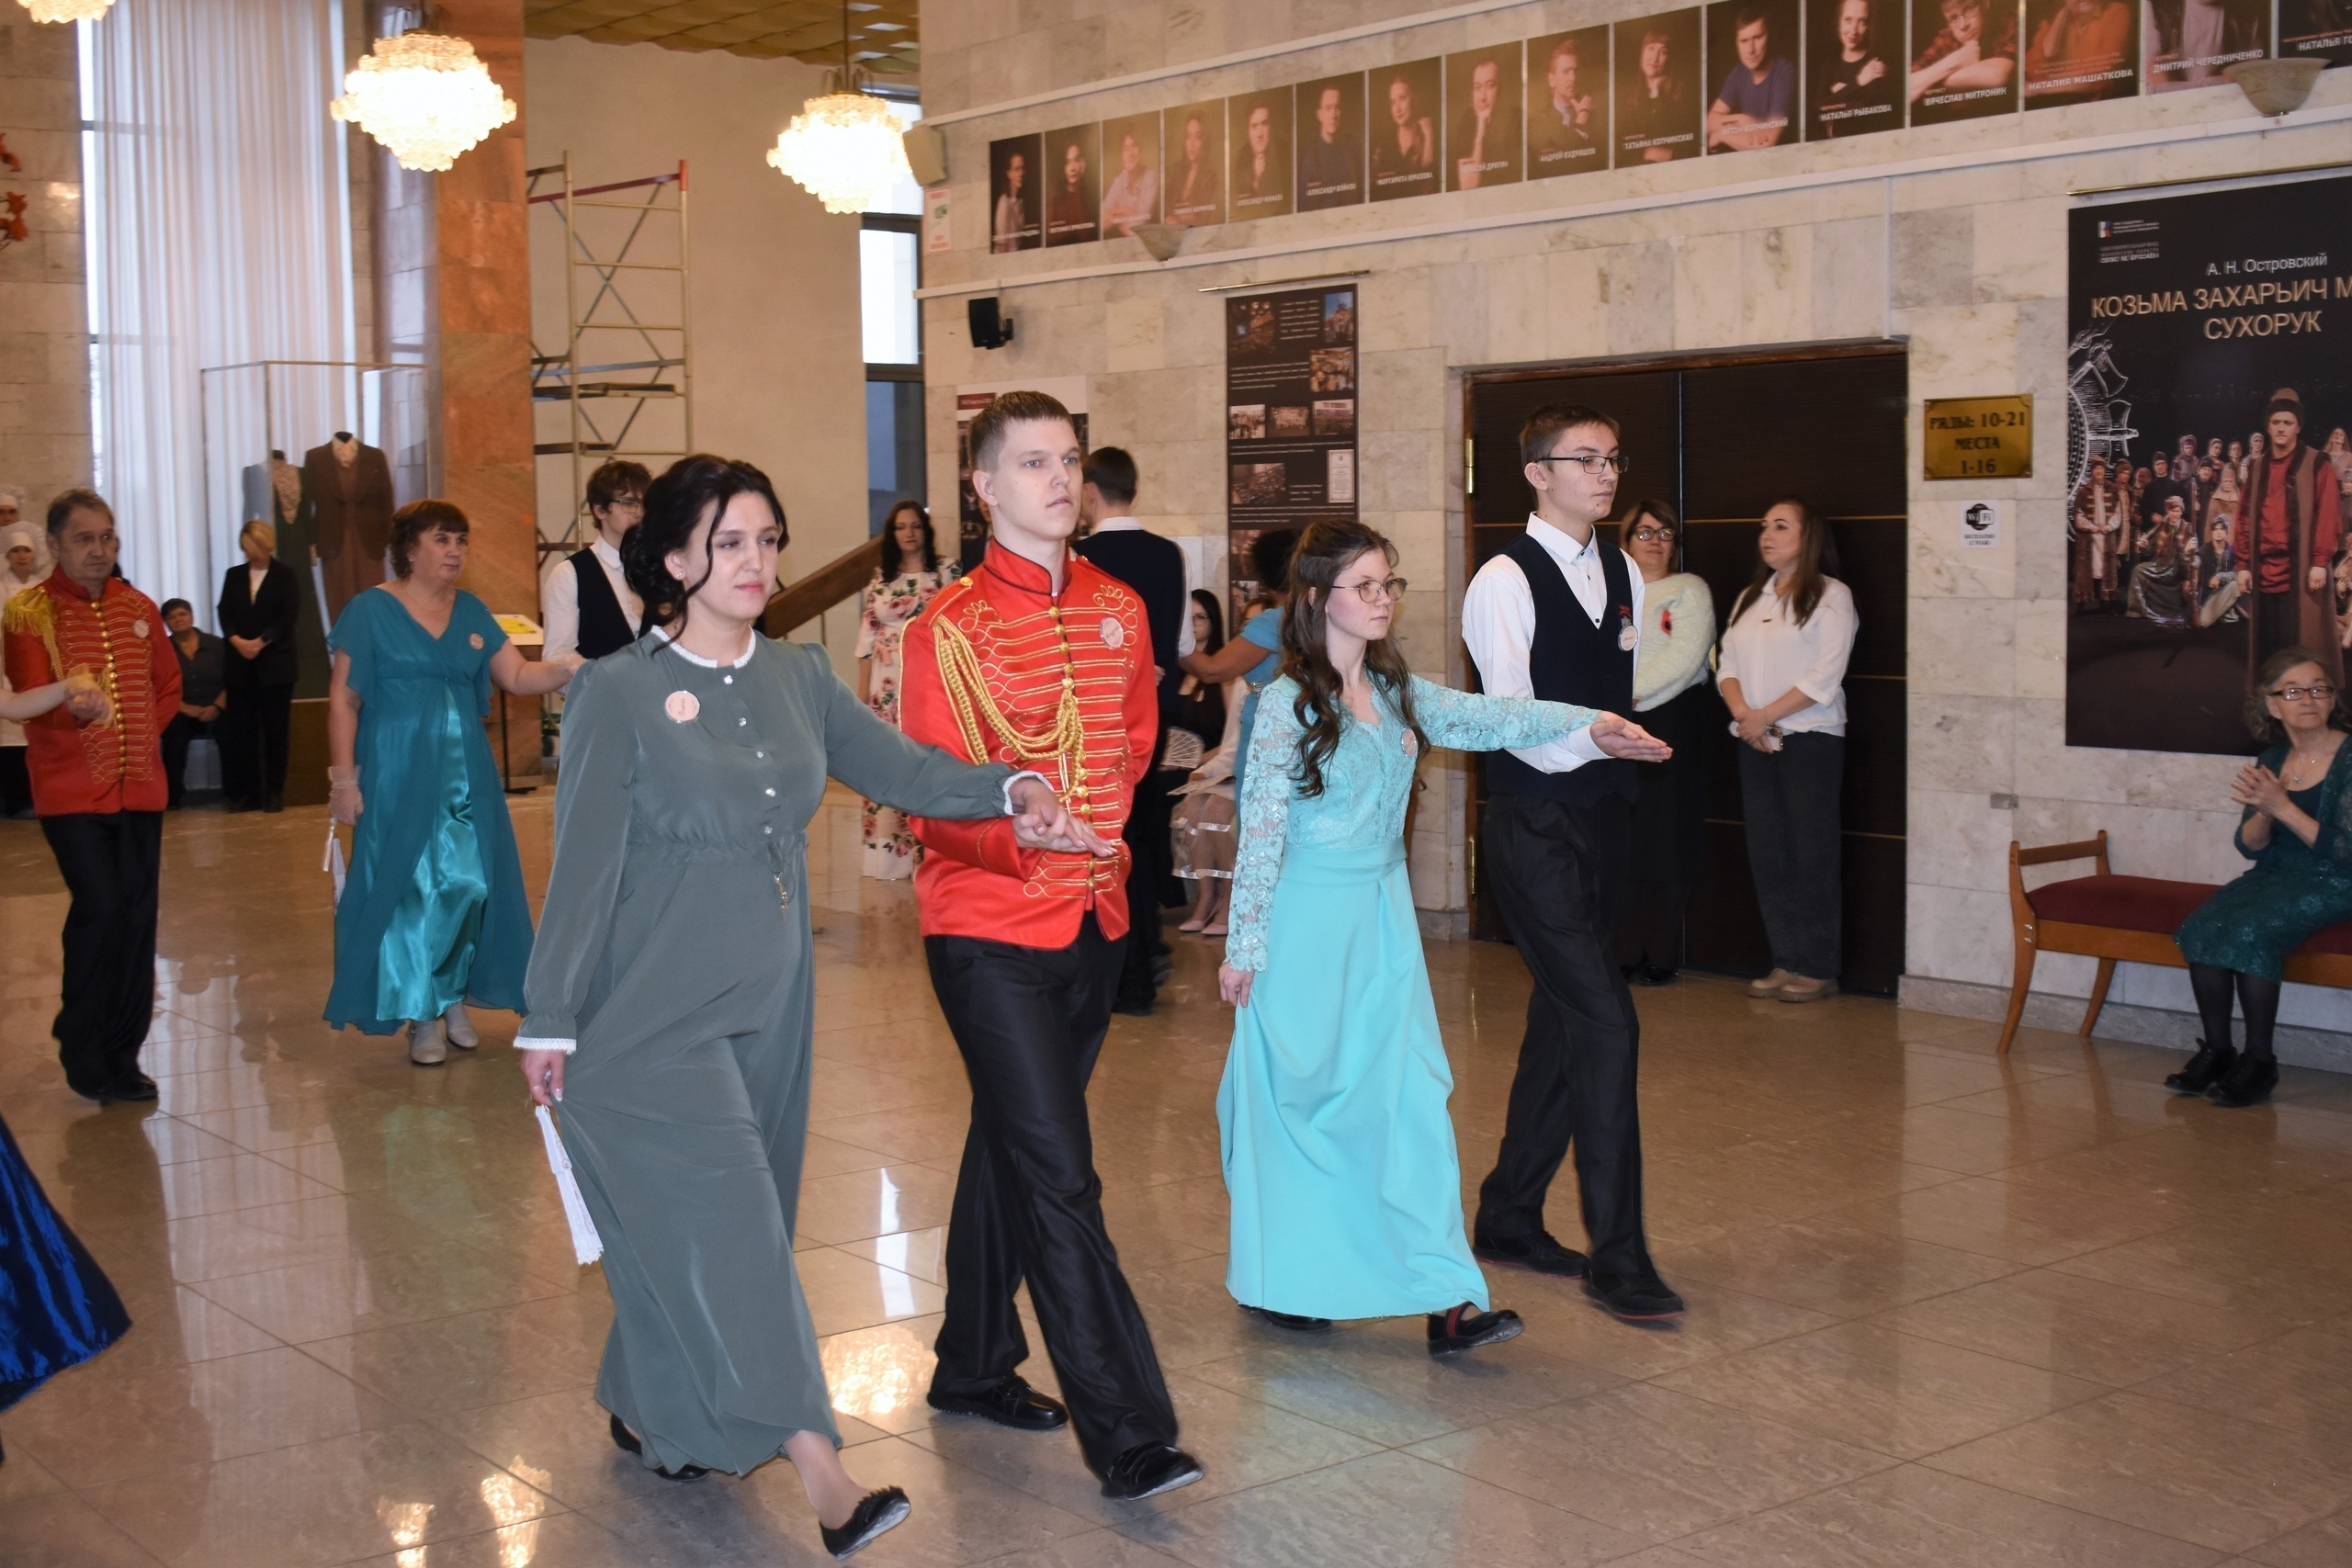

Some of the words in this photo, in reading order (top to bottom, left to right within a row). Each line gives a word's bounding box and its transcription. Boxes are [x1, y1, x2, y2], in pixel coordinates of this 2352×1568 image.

[2299, 38, 2341, 51] НАТАЛЬЯ
[2154, 58, 2195, 74] ДМИТРИЙ
[2196, 49, 2264, 67] ЧЕРЕДНИЧЕНКО
[2029, 78, 2071, 91] НАТАЛИЯ
[2074, 69, 2133, 85] МАШАТКОВА
[1925, 95, 1963, 107] ВЯЧЕСЛАВ
[1964, 86, 2007, 100] МИТРОНИН
[1820, 110, 1853, 121] НАТАЛЬЯ
[1853, 104, 1893, 118] РЫБАКОВА
[1721, 126, 1743, 136] АНТОН
[1624, 140, 1651, 150] ТАТЬЯНА
[2207, 262, 2222, 276] А.
[2224, 261, 2241, 275] Н.
[2244, 253, 2328, 273] Островский
[2091, 290, 2188, 319] КОЗЬМА
[2193, 277, 2328, 310] ЗАХАРЬИЧ
[2203, 310, 2323, 340] СУХОРУК
[1981, 411, 2026, 428] 10-21
[1955, 436, 2001, 450] МЕСТА
[1962, 458, 1997, 474] 1-16
